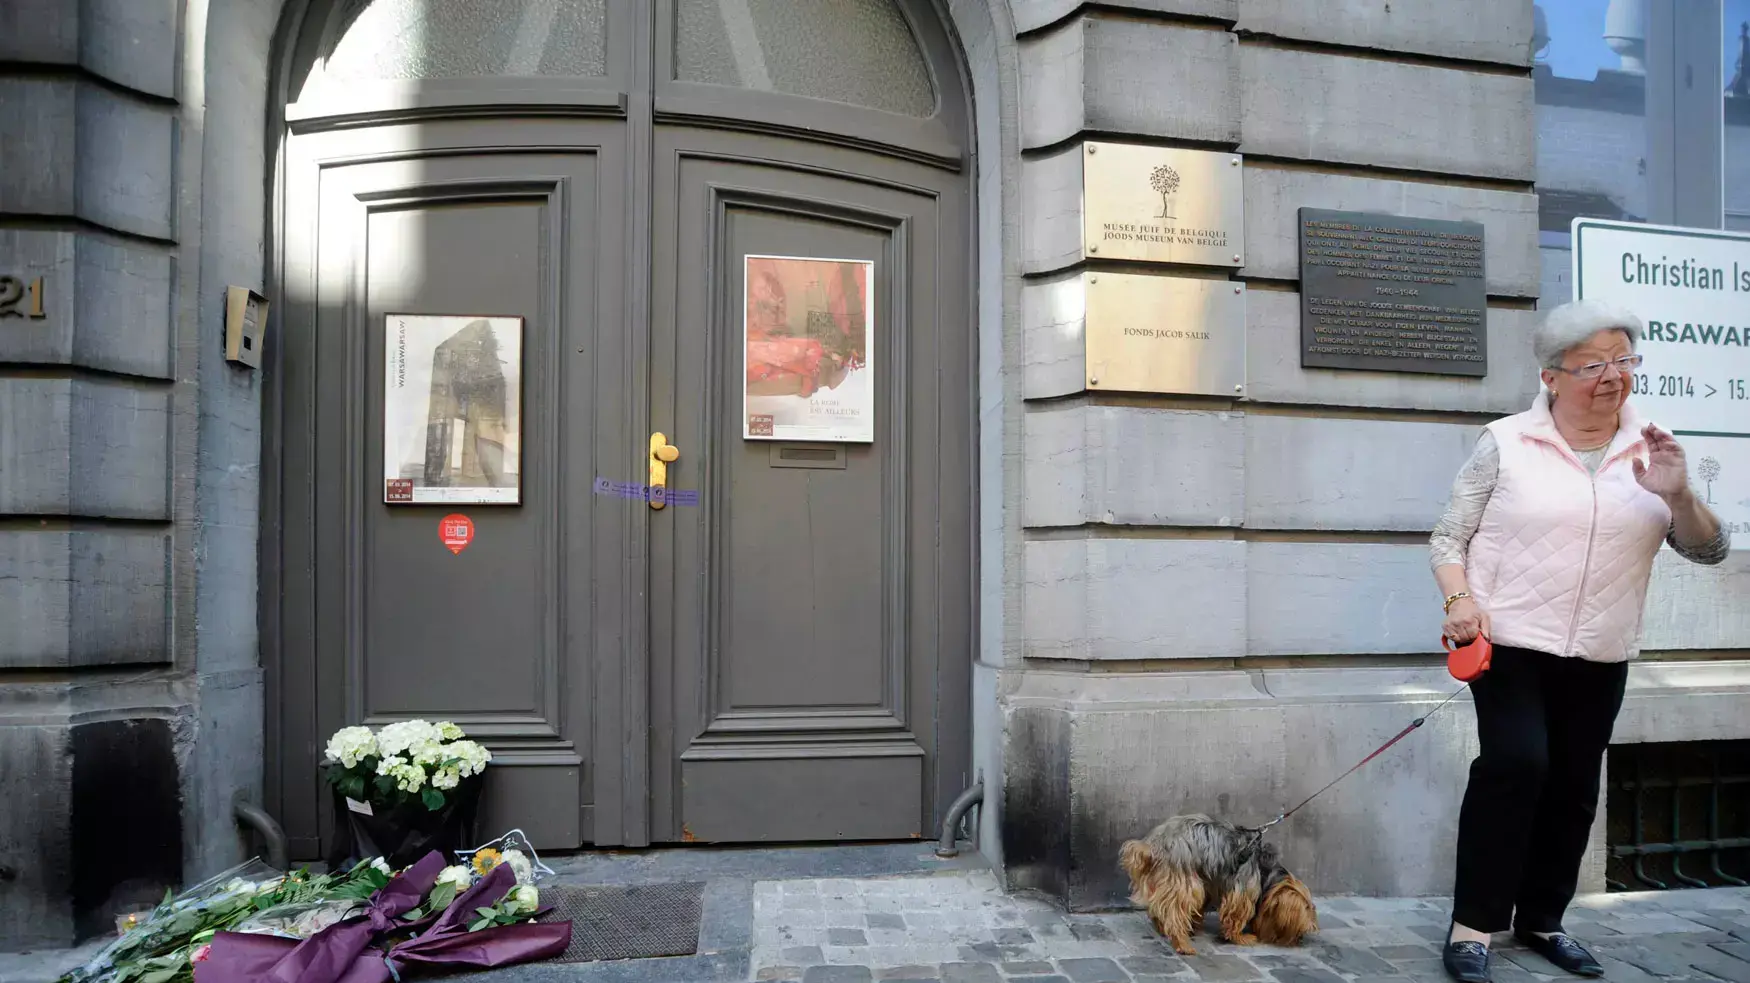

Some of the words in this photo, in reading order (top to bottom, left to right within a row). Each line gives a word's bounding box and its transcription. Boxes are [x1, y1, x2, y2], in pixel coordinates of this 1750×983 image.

[1103, 223, 1136, 232] MUSÉE
[1140, 225, 1160, 233] JUIF
[1164, 227, 1176, 235] DE
[1180, 228, 1227, 238] BELGIQUE
[1103, 232, 1133, 240] JOODS
[1136, 233, 1174, 244] MUSEUM
[1177, 236, 1194, 244] VAN
[1621, 251, 1724, 290] Christian
[1124, 327, 1154, 336] FONDS
[1155, 329, 1184, 339] JACOB
[1185, 330, 1210, 340] SALIK
[1659, 375, 1695, 397] 2014
